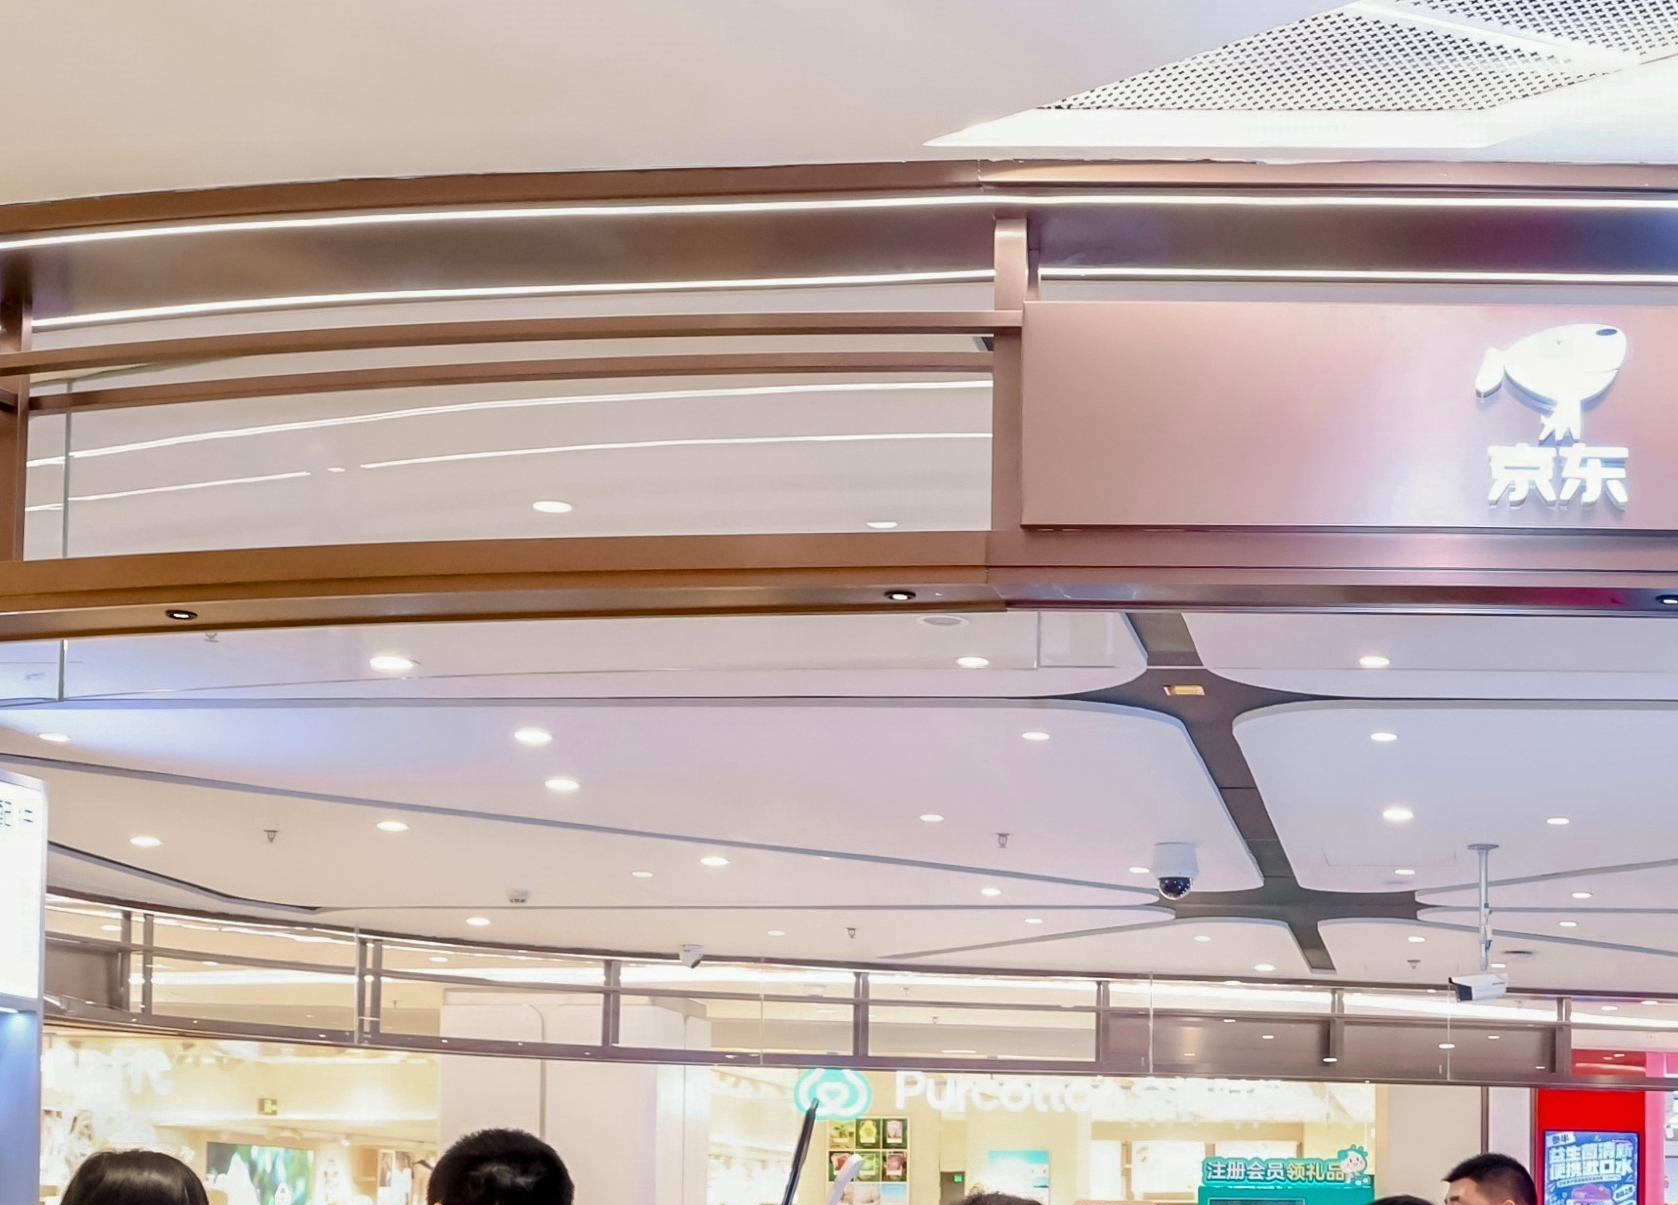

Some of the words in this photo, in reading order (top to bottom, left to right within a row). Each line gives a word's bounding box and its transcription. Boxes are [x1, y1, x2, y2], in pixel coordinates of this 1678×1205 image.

[1487, 445, 1629, 508] 京东
[1206, 1162, 1346, 1181] 注册会员领礼品
